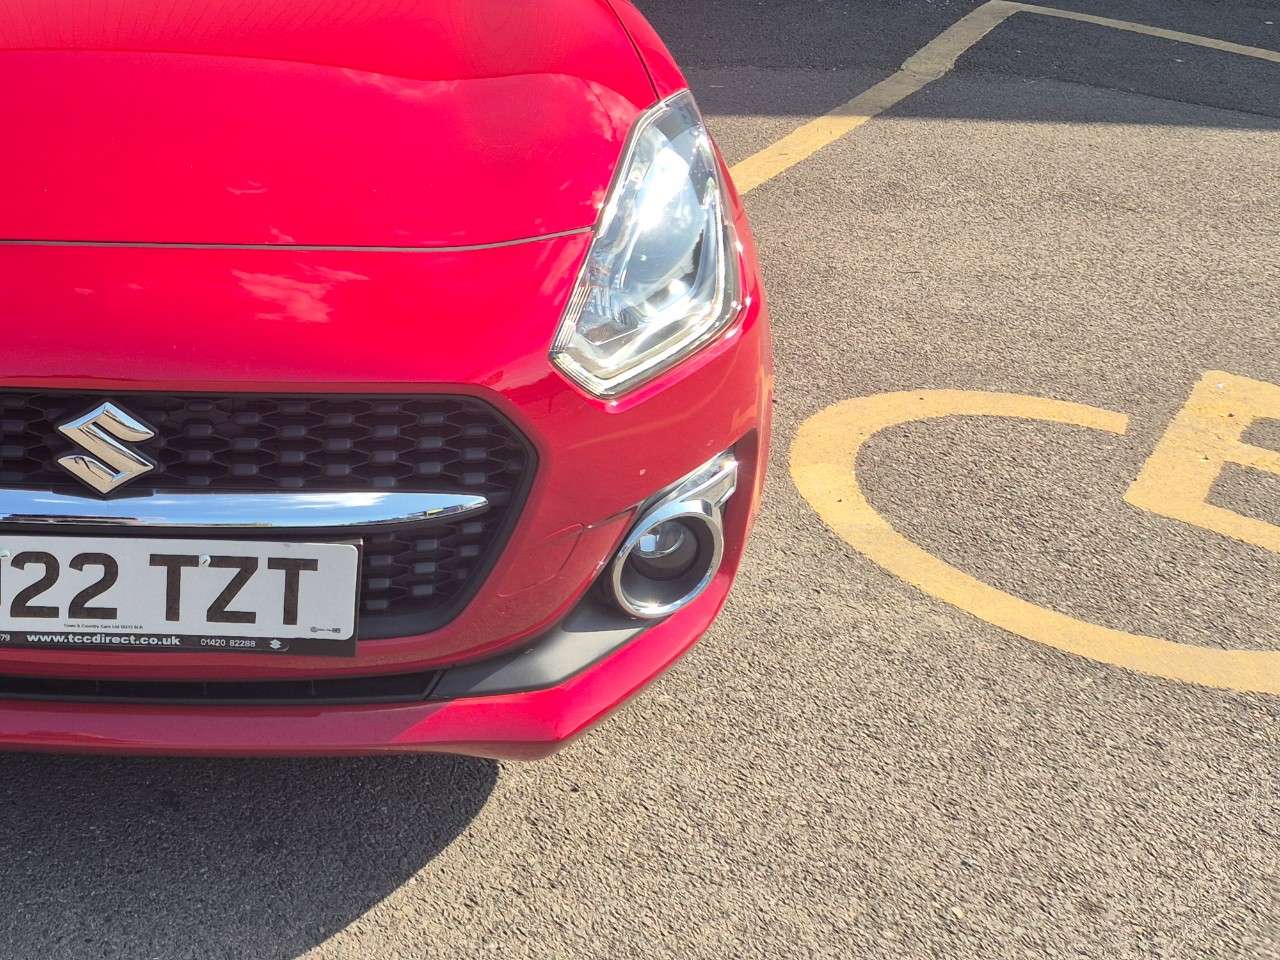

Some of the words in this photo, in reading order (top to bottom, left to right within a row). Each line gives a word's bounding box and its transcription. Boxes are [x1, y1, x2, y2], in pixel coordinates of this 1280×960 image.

[149, 553, 319, 625] TZT
[26, 633, 180, 645] www.tccdirect.co.uk
[200, 638, 226, 647] 01420
